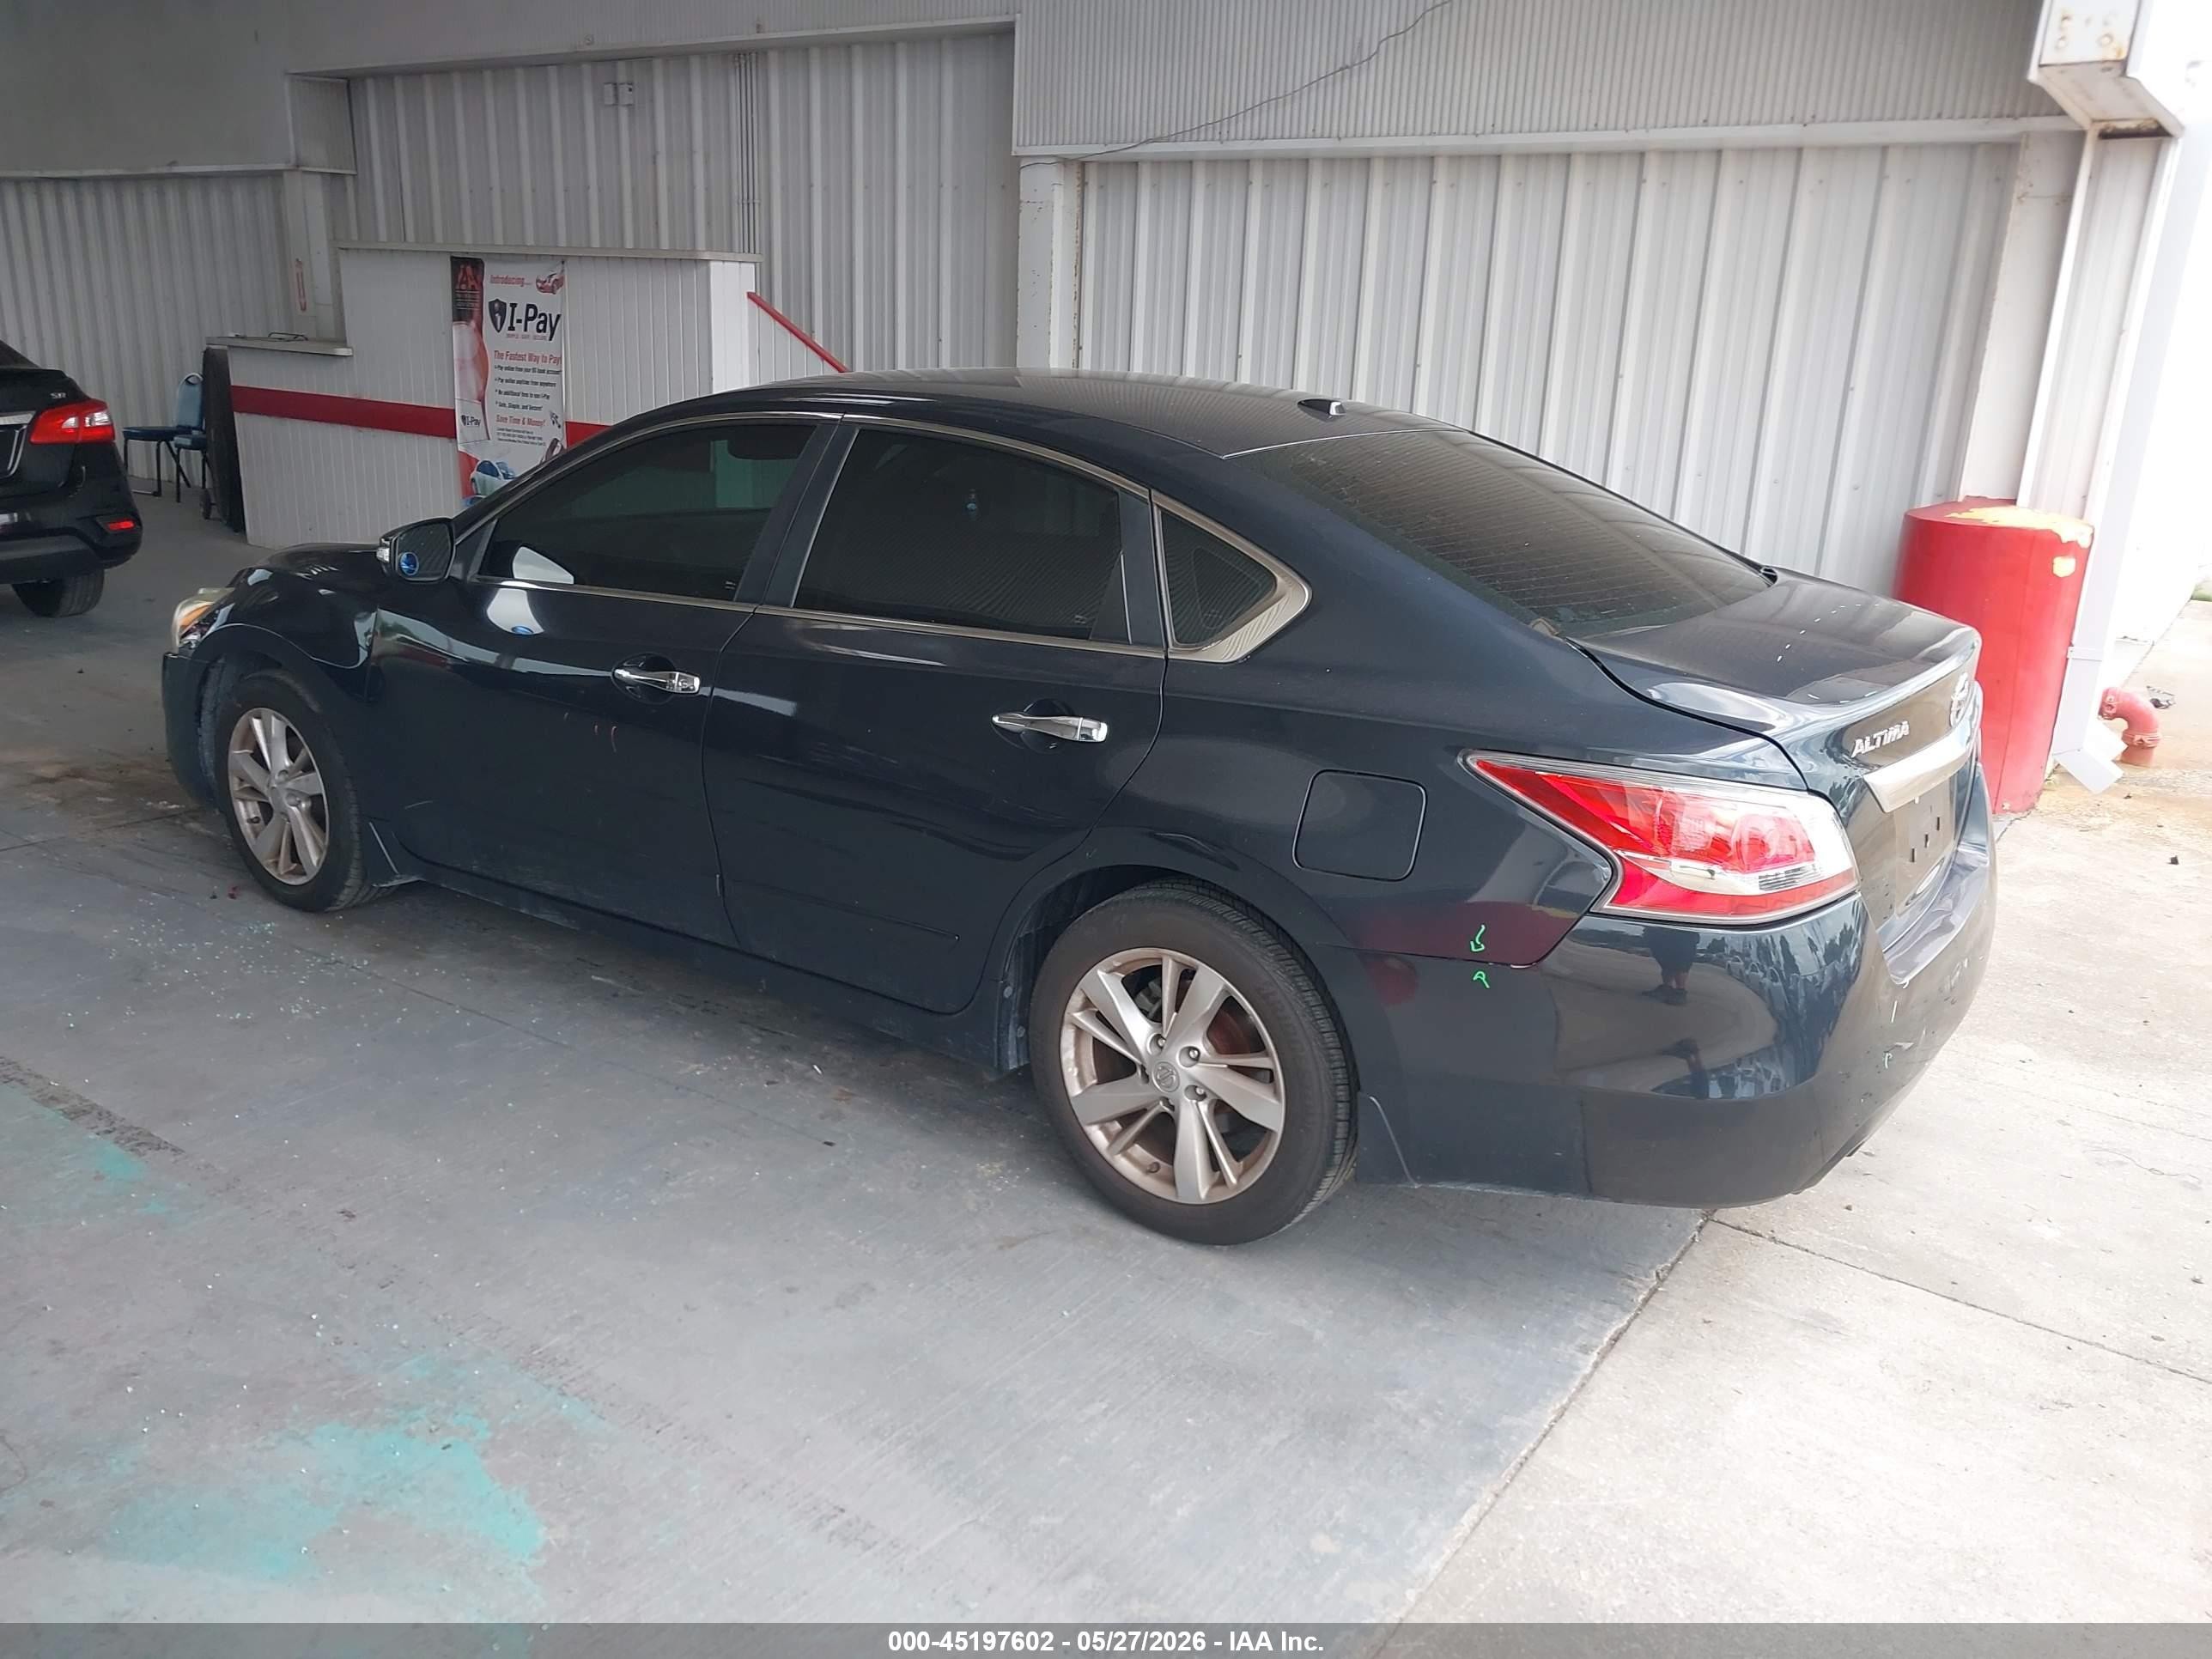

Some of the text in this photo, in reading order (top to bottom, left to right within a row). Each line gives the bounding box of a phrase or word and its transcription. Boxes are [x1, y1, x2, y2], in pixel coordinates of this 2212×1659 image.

[507, 302, 562, 341] I-Pay
[494, 349, 504, 360] The
[506, 350, 526, 362] Fastest
[528, 352, 540, 365] Way
[542, 354, 548, 363] to
[466, 416, 481, 427] I-Pay
[496, 414, 508, 423] Save
[508, 415, 520, 425] Time
[1850, 720, 1910, 758] ALTIMA
